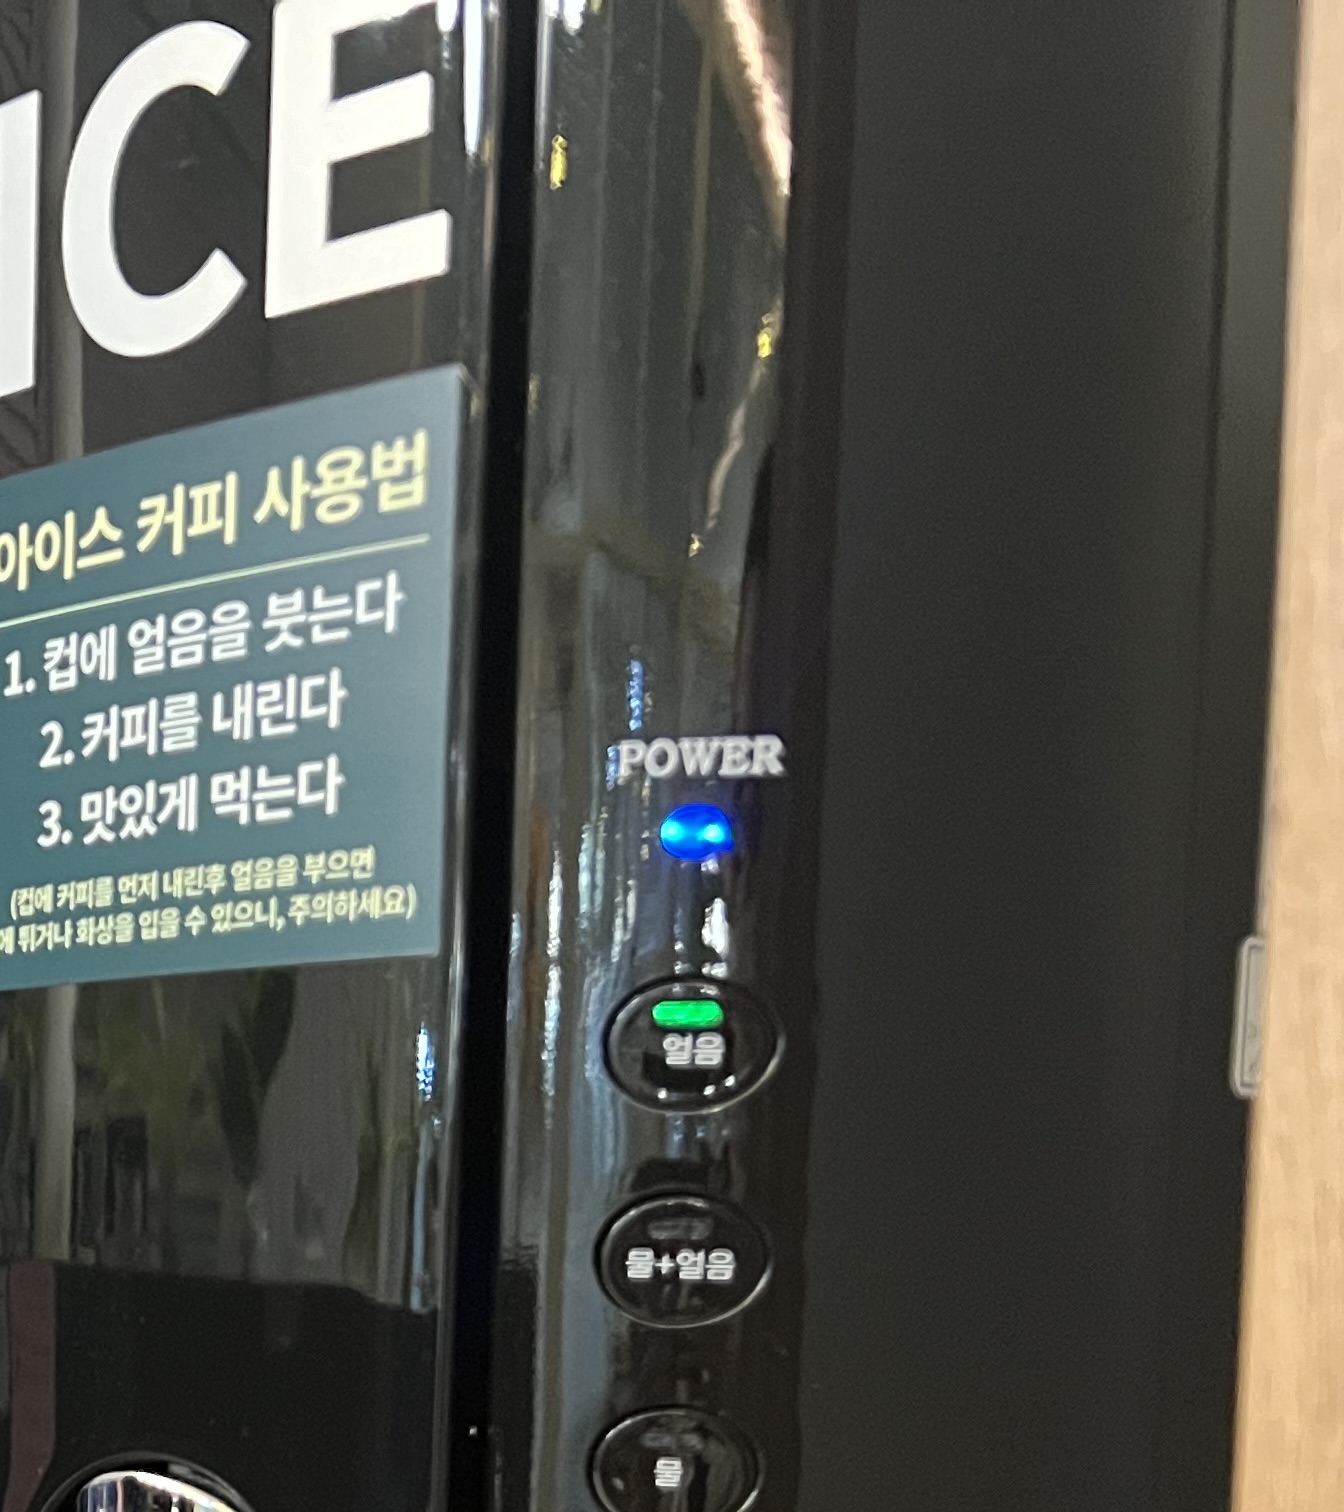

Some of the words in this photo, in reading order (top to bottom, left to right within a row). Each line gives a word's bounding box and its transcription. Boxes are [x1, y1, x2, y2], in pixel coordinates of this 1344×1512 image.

[137, 472, 238, 556] 커피
[252, 429, 429, 531] 사용법
[3, 650, 36, 696] 1.
[43, 625, 117, 692] 컵에
[127, 600, 251, 676] 얼음을
[261, 570, 404, 654] 붓는다
[38, 721, 74, 768] 2.
[81, 691, 202, 762] 커피를
[213, 668, 348, 741] 내린다
[617, 734, 786, 778] POWER
[37, 801, 73, 848] 3.
[81, 773, 199, 844] 맛있게
[210, 755, 345, 825] 먹는다
[56, 877, 114, 912] 커피를
[118, 871, 158, 906] 먼저
[231, 854, 299, 894] 얼음을
[303, 844, 375, 888] 부으면
[662, 1032, 726, 1070] 얼음
[626, 1246, 736, 1282] 물+얼음
[653, 1456, 683, 1487] 물
